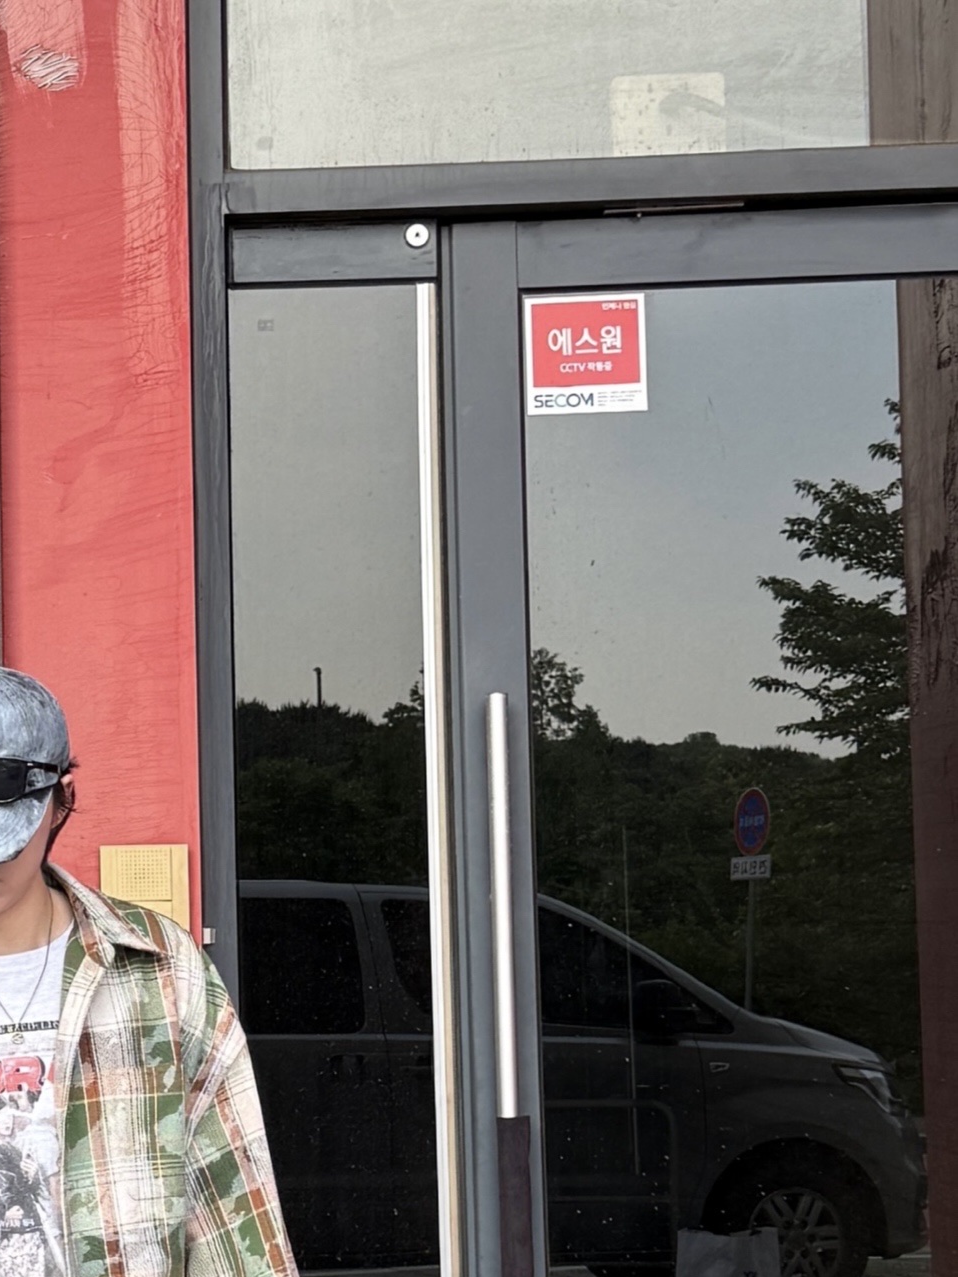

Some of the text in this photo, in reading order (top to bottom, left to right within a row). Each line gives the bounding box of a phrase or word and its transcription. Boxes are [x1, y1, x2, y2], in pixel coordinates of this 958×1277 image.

[547, 325, 622, 356] 에스원
[560, 363, 586, 373] CCTV
[534, 392, 594, 408] SECOM
